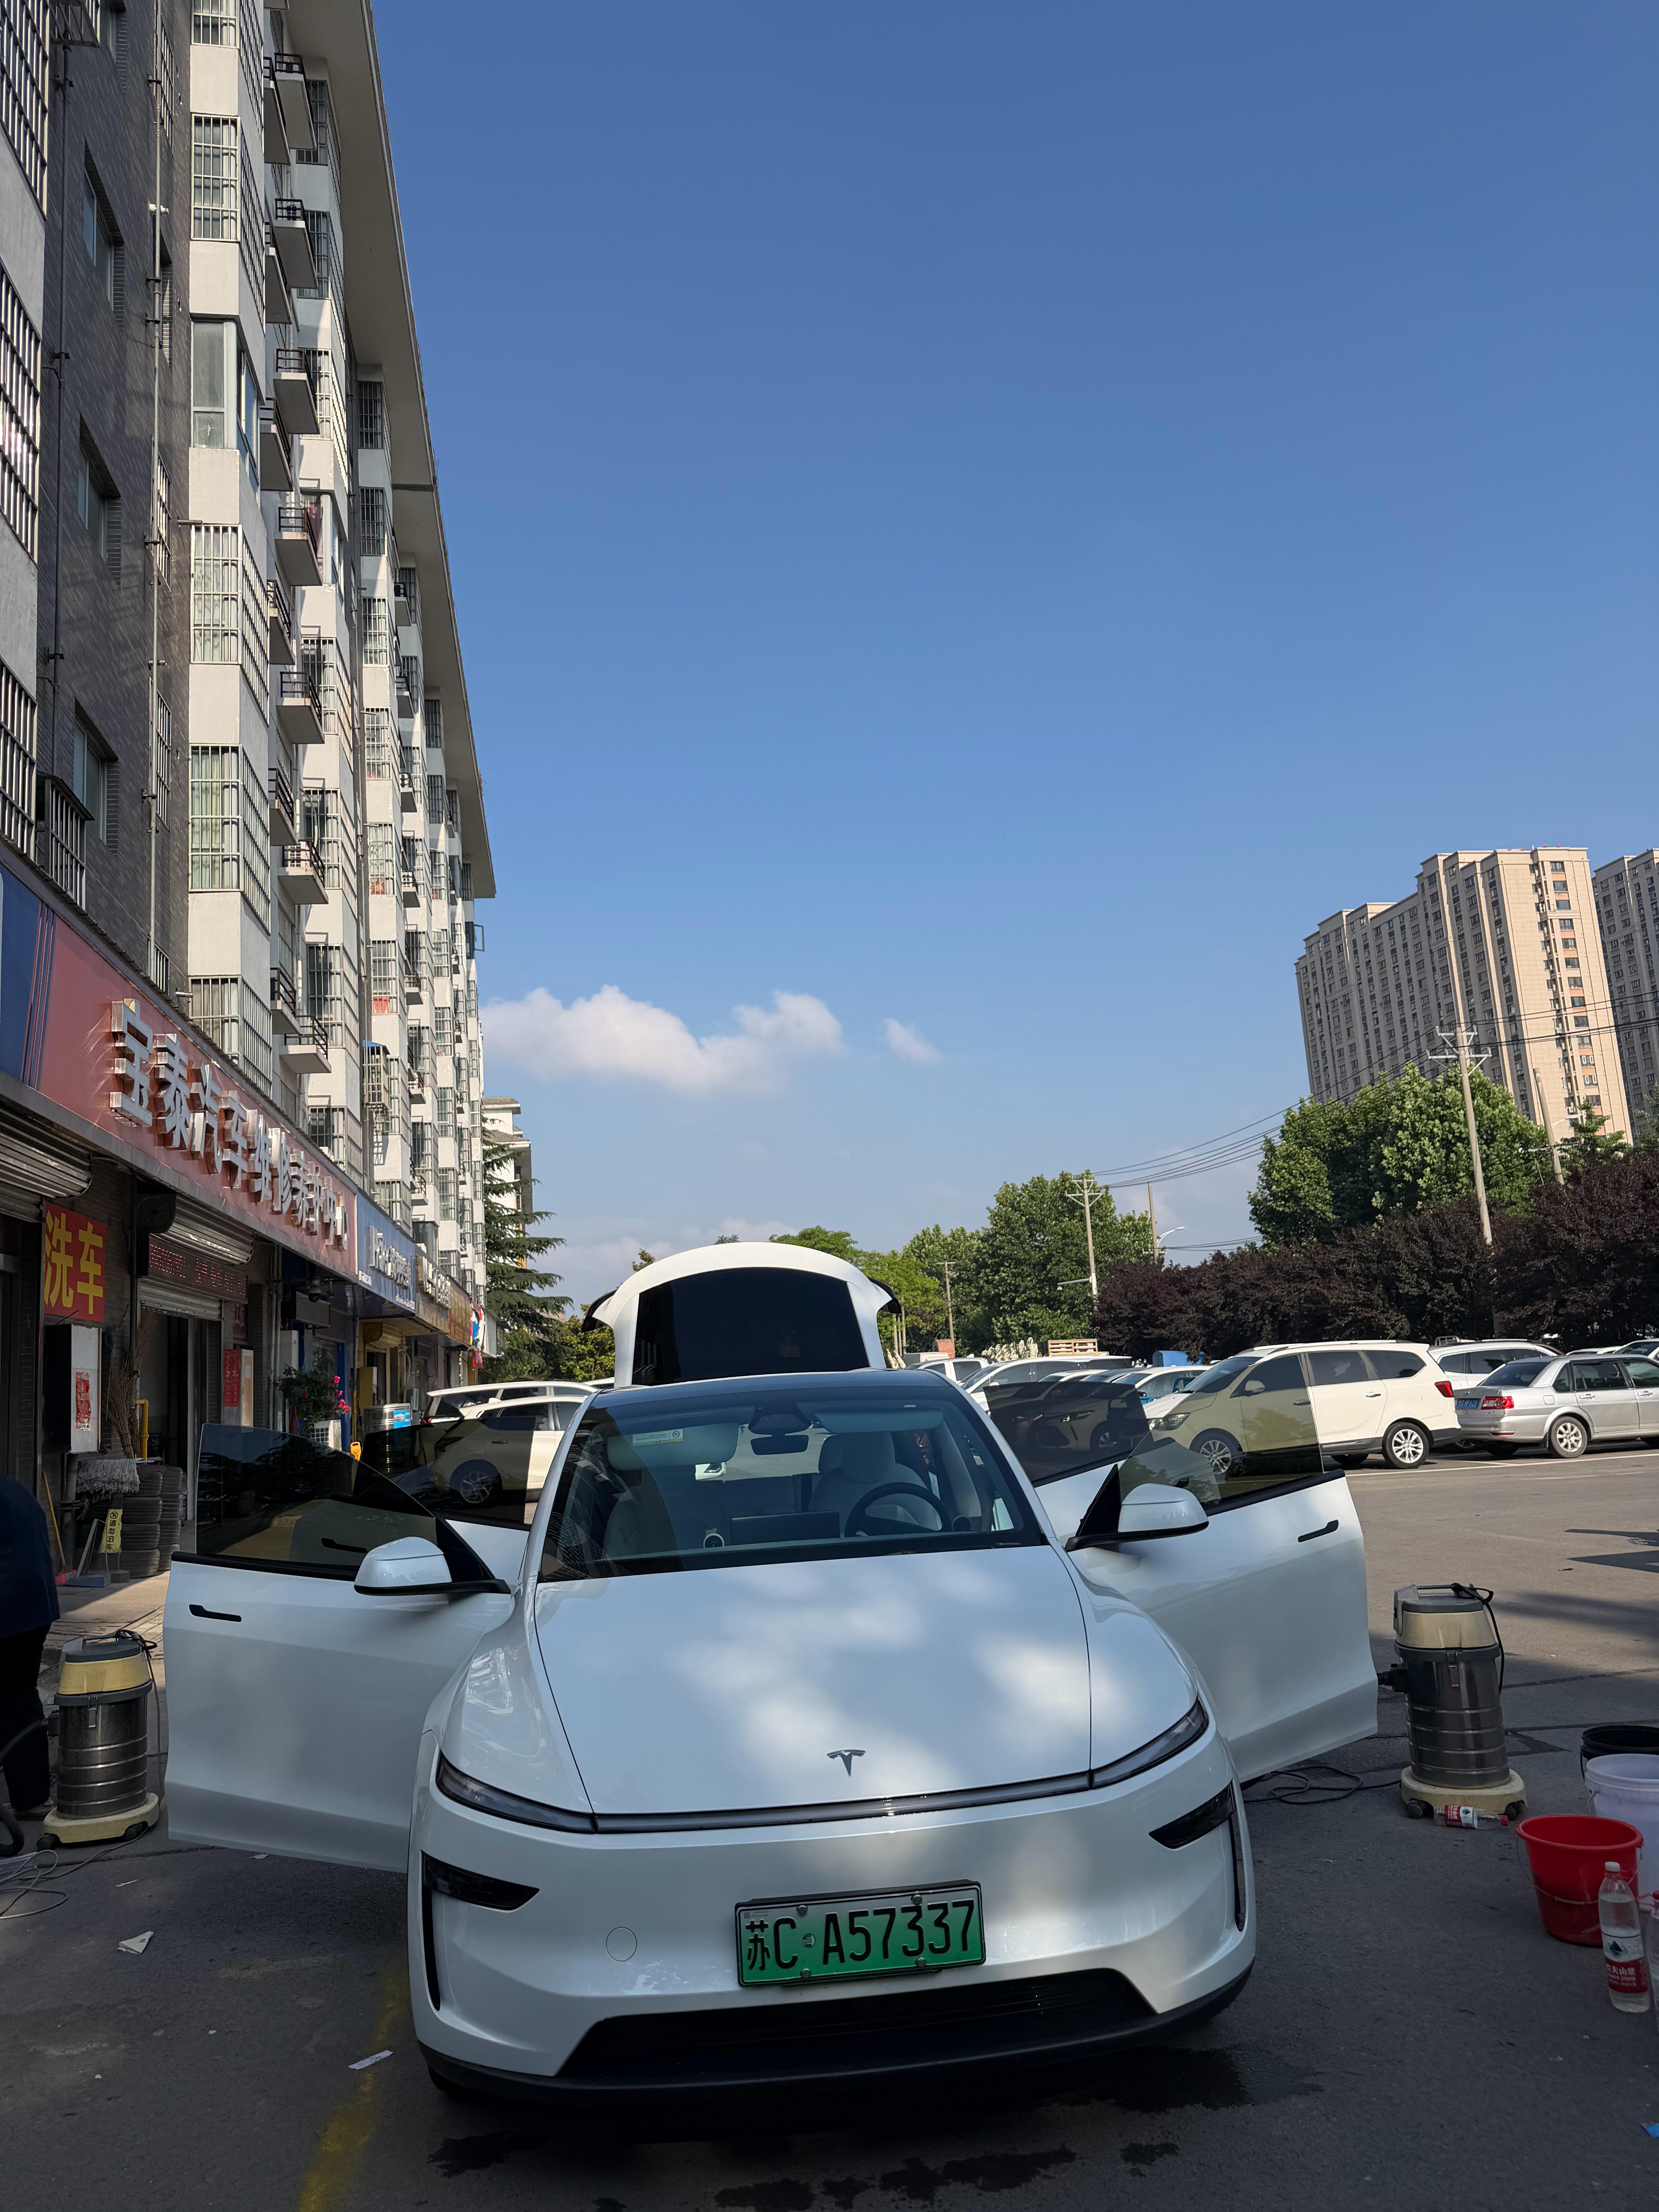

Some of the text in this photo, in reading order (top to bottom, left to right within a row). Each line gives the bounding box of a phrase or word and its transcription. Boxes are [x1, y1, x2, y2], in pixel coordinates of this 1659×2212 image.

[110, 998, 349, 1251] 宝泰汽车维修养护中心
[45, 1211, 104, 1315] 洗车
[107, 1520, 117, 1550] 请勿泊车
